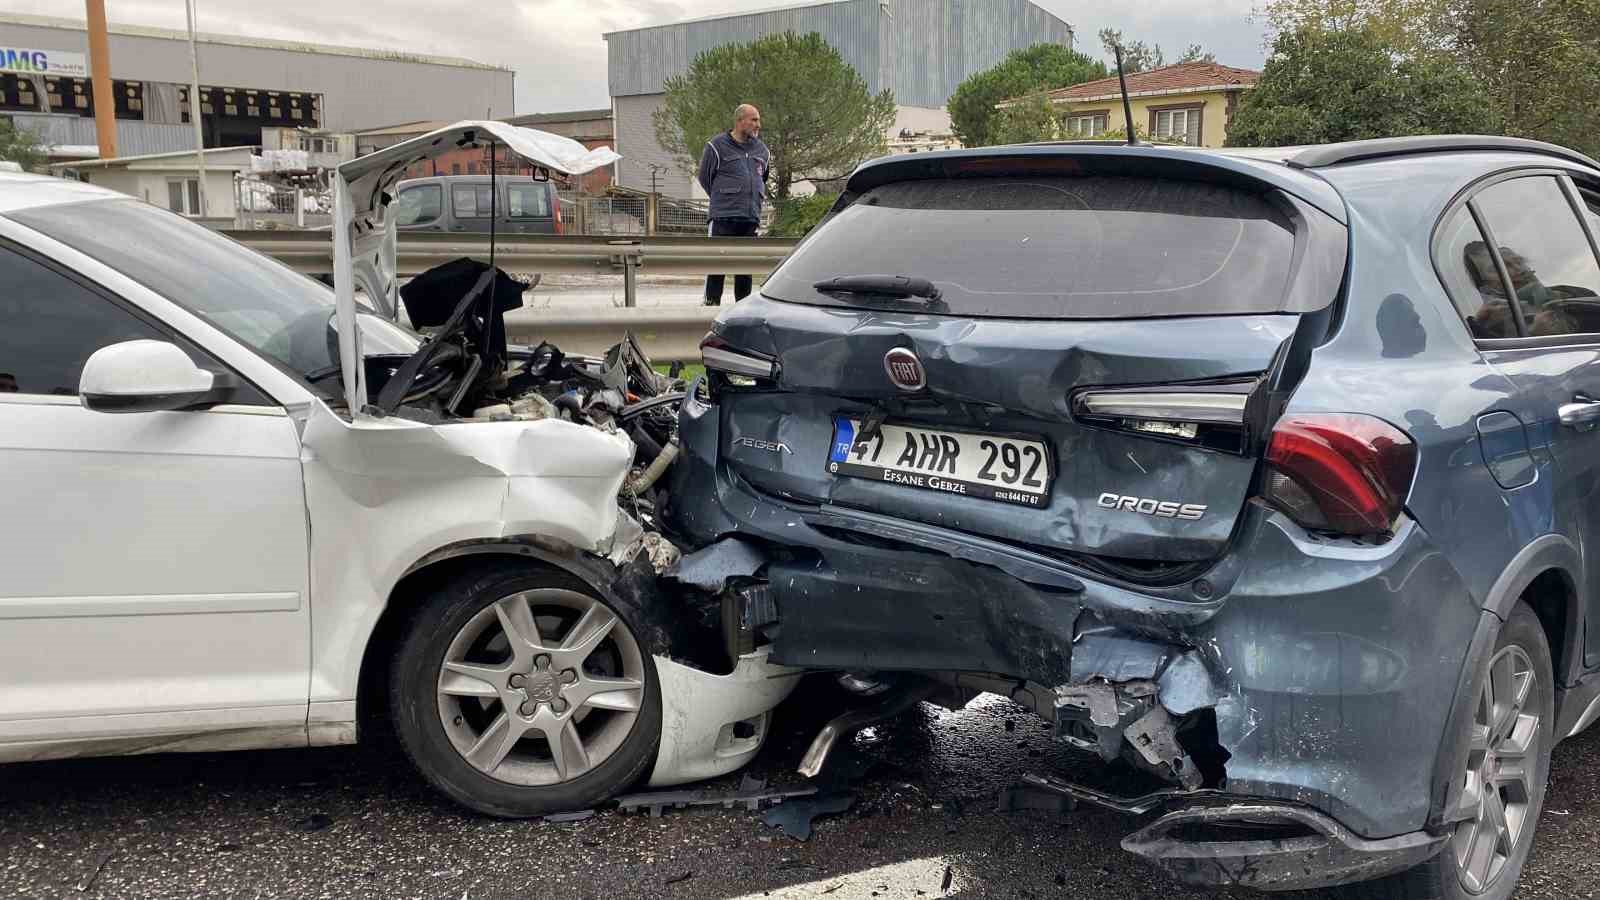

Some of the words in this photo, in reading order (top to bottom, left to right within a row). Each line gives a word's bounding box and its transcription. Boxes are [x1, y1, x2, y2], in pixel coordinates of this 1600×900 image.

[892, 362, 918, 381] FIAT
[837, 442, 849, 456] TR
[896, 431, 960, 474] AHR
[977, 440, 1042, 487] 292
[1097, 492, 1208, 520] CROSS
